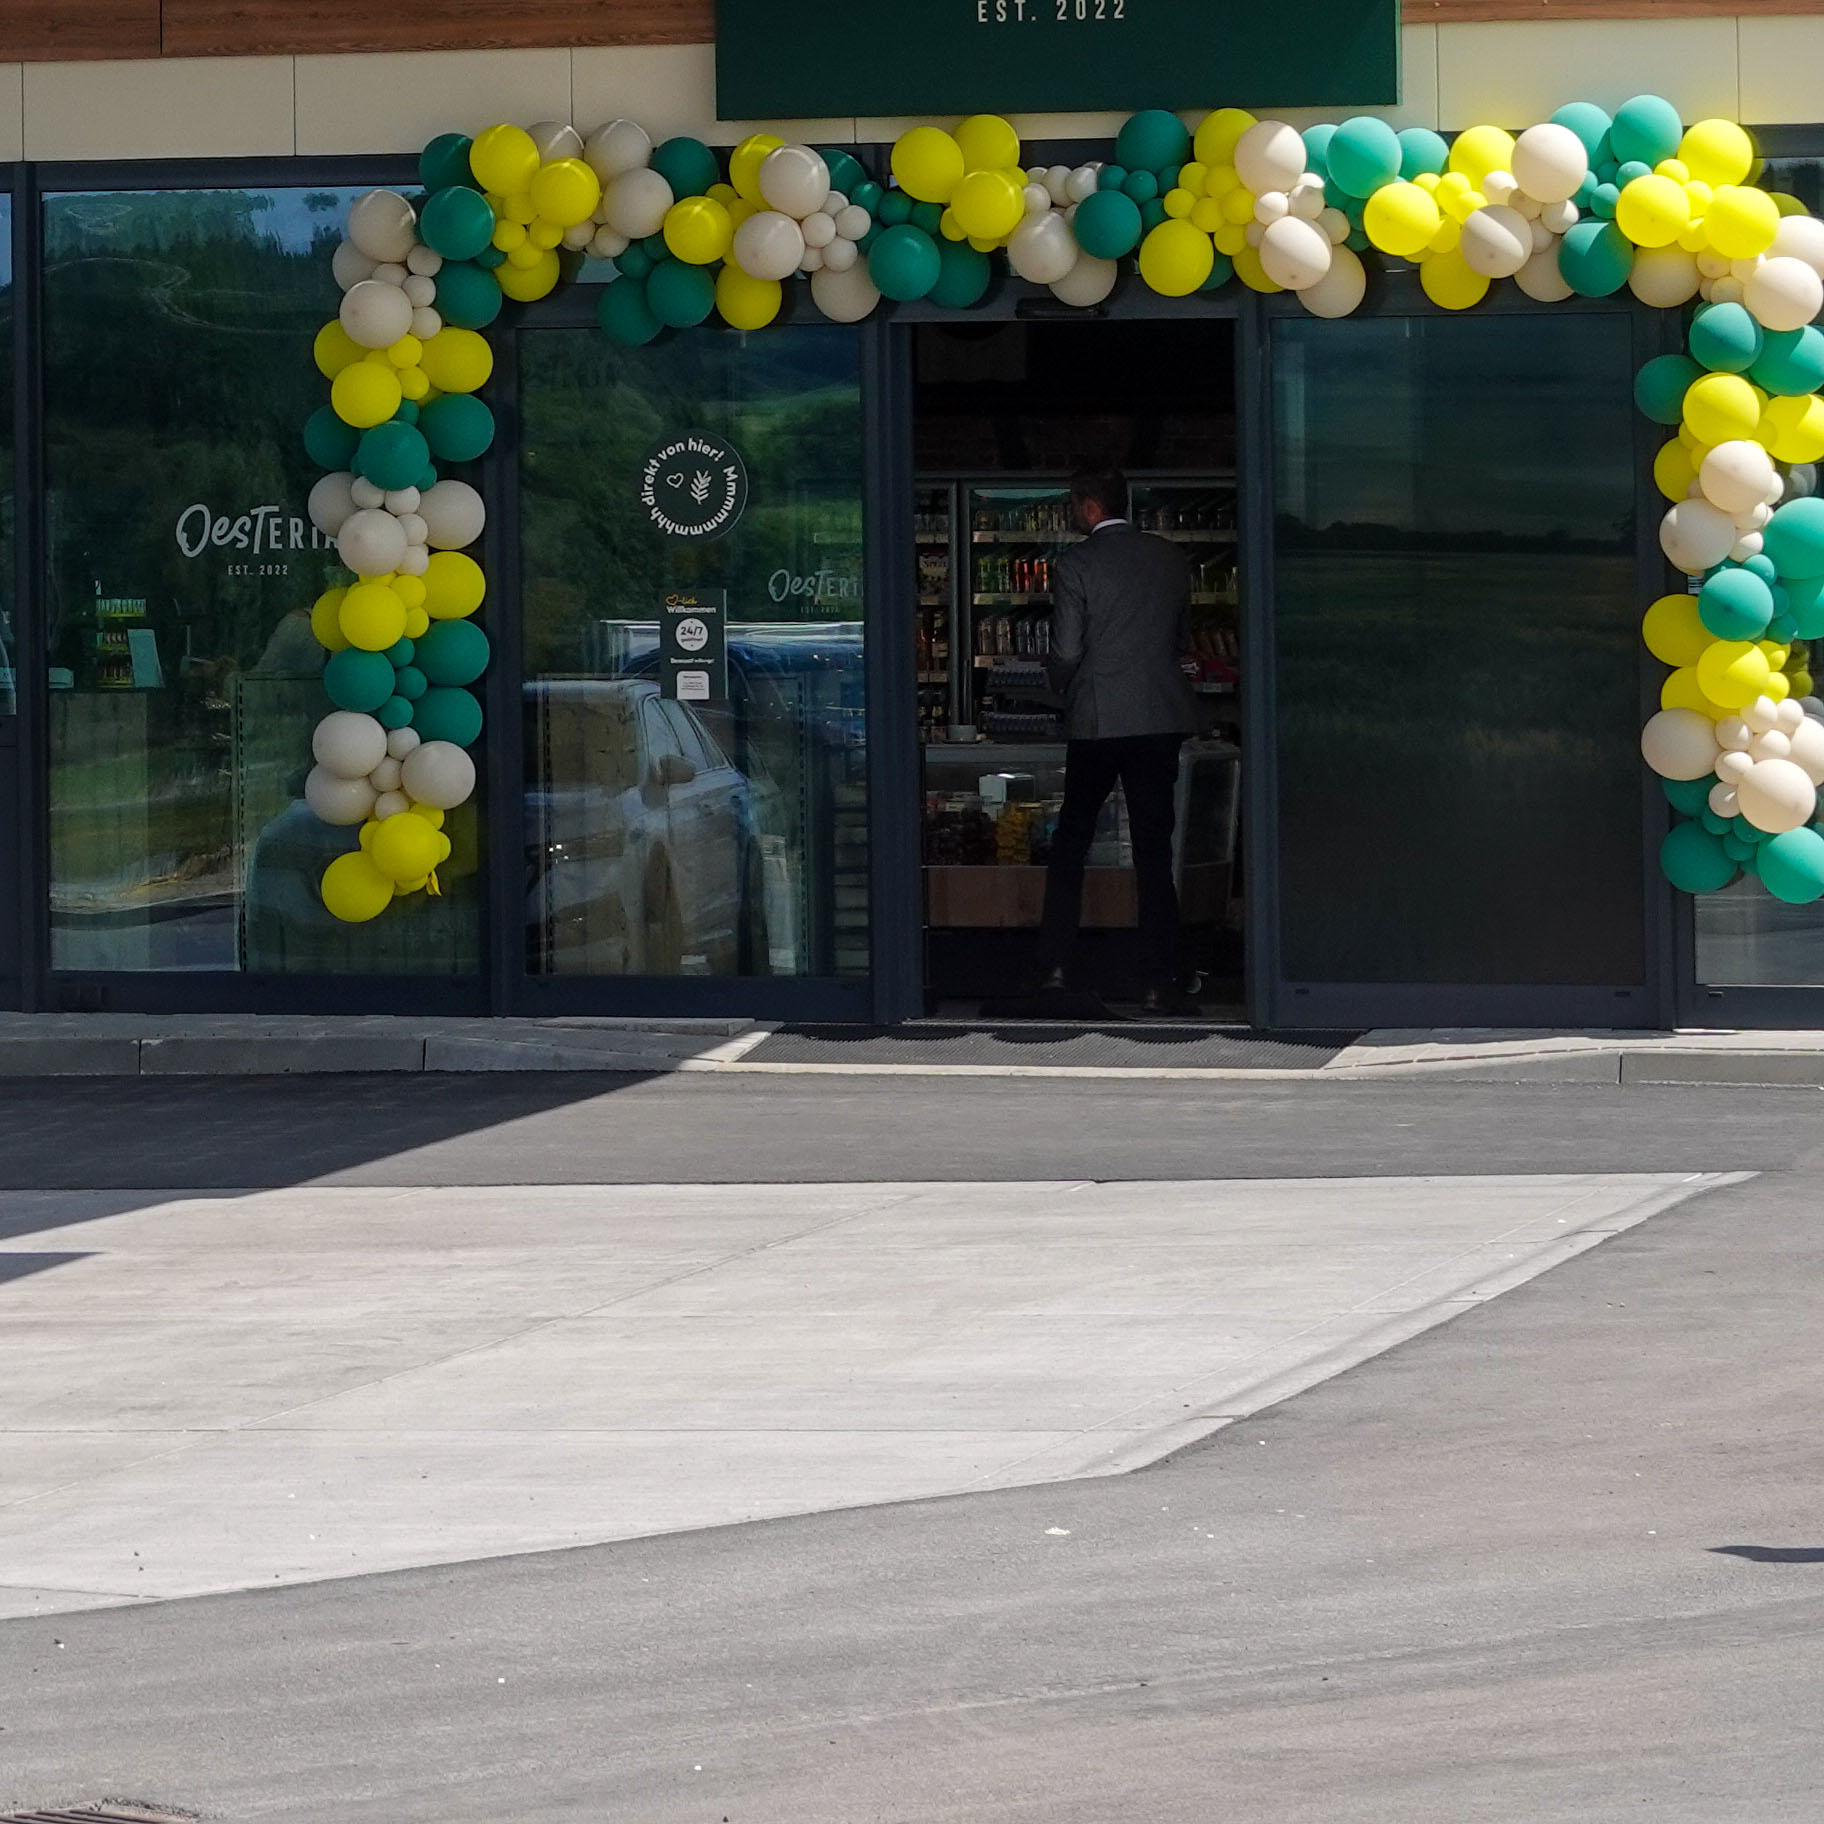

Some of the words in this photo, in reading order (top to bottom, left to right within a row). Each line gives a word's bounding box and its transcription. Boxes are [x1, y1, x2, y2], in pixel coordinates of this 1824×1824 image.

[640, 458, 661, 506] direkt
[657, 442, 686, 460] von
[687, 437, 725, 462] hier!
[259, 564, 288, 576] 2022
[680, 625, 704, 636] 24/7
